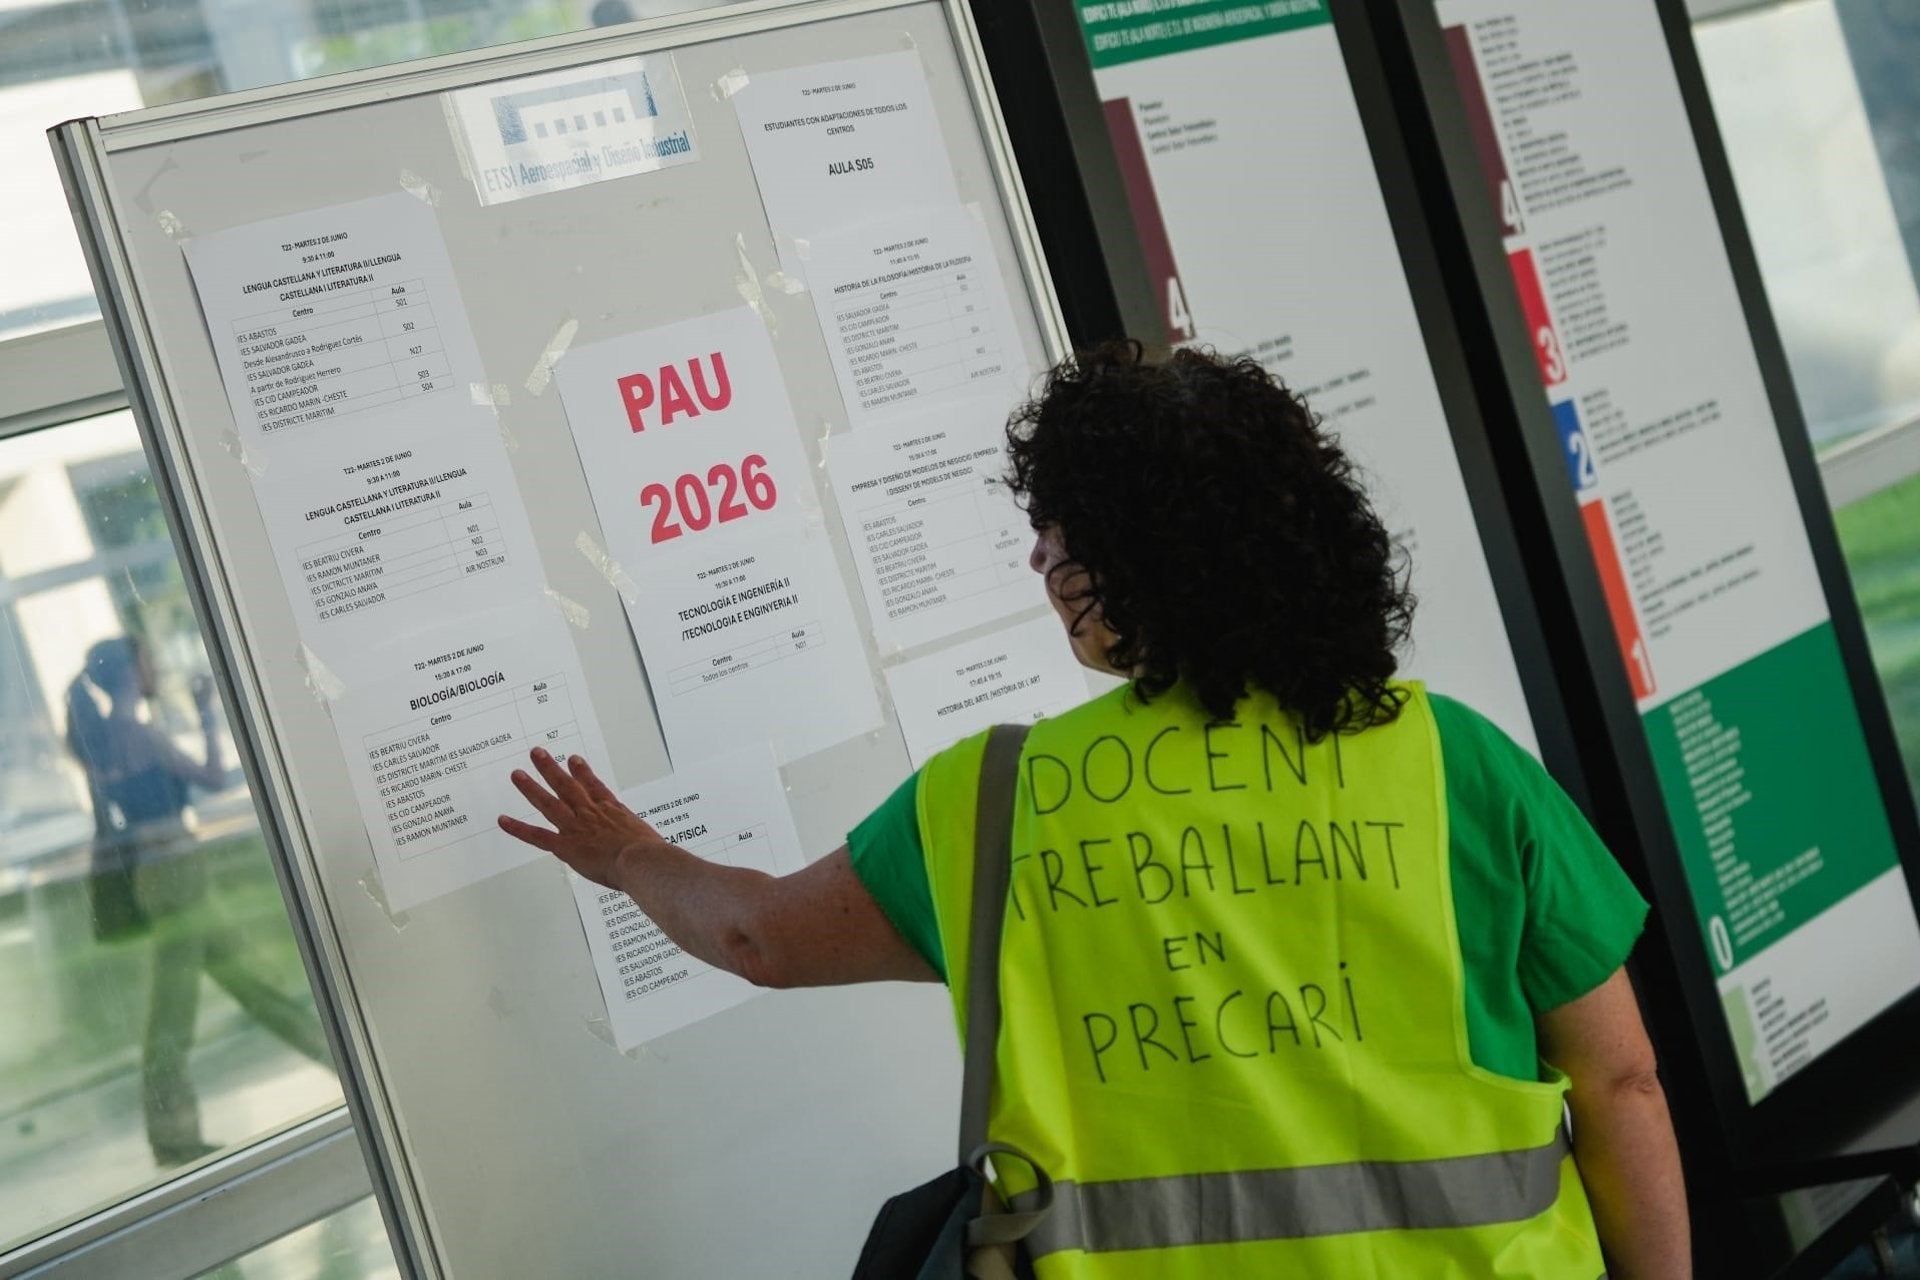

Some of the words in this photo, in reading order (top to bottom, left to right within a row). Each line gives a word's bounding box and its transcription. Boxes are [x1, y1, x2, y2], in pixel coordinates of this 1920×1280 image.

[764, 118, 805, 131] ESTUDIANTES
[805, 116, 820, 124] CON
[820, 109, 865, 122] ADAPTACIONES
[865, 107, 874, 116] DE
[874, 105, 895, 114] TODOS
[895, 102, 907, 111] LOS
[826, 125, 854, 135] CENTROS
[483, 165, 518, 192] ETSI
[519, 150, 593, 187] Aeroespacial
[639, 130, 691, 159] Industrial
[829, 161, 855, 175] AULA
[855, 157, 874, 170] S05
[294, 239, 316, 249] MARTES
[321, 236, 330, 244] DE
[330, 232, 348, 242] JUNIO
[242, 281, 272, 294] LENGUA
[272, 272, 316, 287] CASTELLANA
[321, 261, 362, 277] LITERATURA
[280, 285, 323, 301] CASTELLANA
[326, 275, 368, 291] LITERATURA
[391, 286, 405, 295] Aula
[292, 308, 314, 317] Centro
[395, 298, 407, 307] S01
[1167, 277, 1193, 338] 4
[237, 334, 248, 343] IES
[249, 328, 277, 340] ABASTOS
[402, 322, 415, 331] S02
[240, 347, 251, 356] IES
[251, 339, 284, 354] SALVADOR
[284, 334, 307, 346] GADEA
[409, 345, 422, 355] N27
[1537, 326, 1563, 381] 3
[243, 358, 264, 369] Desde
[316, 367, 341, 378] Herrero
[417, 369, 430, 379] S03
[254, 397, 264, 406] IES
[264, 394, 276, 404] CID
[277, 384, 318, 401] CAMPEADOR
[421, 382, 433, 391] S04
[617, 352, 732, 433] PAU
[257, 410, 268, 419] IES
[268, 402, 298, 416] RICARDO
[261, 422, 272, 431] IES
[272, 414, 304, 429] DISTRICTE
[305, 407, 335, 420] MARITIM
[1569, 431, 1598, 487] 2
[305, 506, 336, 520] LENGUA
[336, 492, 383, 512] CASTELLANA
[388, 479, 429, 496] LITERATURA
[344, 505, 391, 524] CASTELLANA
[395, 492, 436, 510] LITERATURA
[458, 501, 472, 510] Aula
[640, 454, 777, 544] 2026
[358, 528, 381, 540] Centro
[467, 524, 479, 534] N01
[302, 561, 313, 570] IES
[313, 553, 340, 567] BEATRIU
[340, 546, 364, 559] CIVERA
[475, 548, 488, 556] N03
[466, 564, 476, 573] AIR
[476, 555, 504, 570] NOSTRUM
[310, 586, 322, 595] IES
[353, 566, 384, 581] MARITIM
[319, 610, 330, 620] IES
[330, 603, 354, 616] CARLES
[353, 593, 386, 609] SALVADOR
[678, 597, 731, 621] TECNOLOGÍA
[738, 580, 784, 602] INGENIERÍA
[783, 577, 790, 587] II
[743, 597, 791, 620] ENGINYERIA
[791, 594, 798, 604] II
[791, 630, 805, 639] Aula
[712, 655, 732, 666] Centro
[1632, 638, 1655, 692] 1
[410, 672, 505, 710] BIOLOGÍA/BIOLOGÍA
[533, 682, 547, 692] Aula
[430, 714, 452, 725] Centro
[368, 750, 380, 759] IES
[380, 742, 406, 756] BEATRIU
[407, 733, 430, 747] CIVERA
[376, 774, 387, 784] IES
[387, 764, 419, 781] DISTRICTE
[419, 754, 448, 769] MARITIM
[448, 750, 458, 760] IES
[458, 740, 490, 756] SALVADOR
[490, 733, 512, 746] GADEA
[380, 787, 391, 797] IES
[390, 777, 419, 793] RICARDO
[444, 761, 468, 775] CHESTE
[395, 836, 406, 846] IES
[406, 828, 431, 842] RAMON
[431, 814, 468, 833] MUNTANER
[738, 830, 752, 842] Aula
[1010, 820, 1404, 920] TREBALLANT
[1163, 932, 1226, 971] EN
[634, 966, 663, 982] ABASTOS
[636, 984, 649, 995] CID
[649, 969, 688, 990] CAMPEADOR
